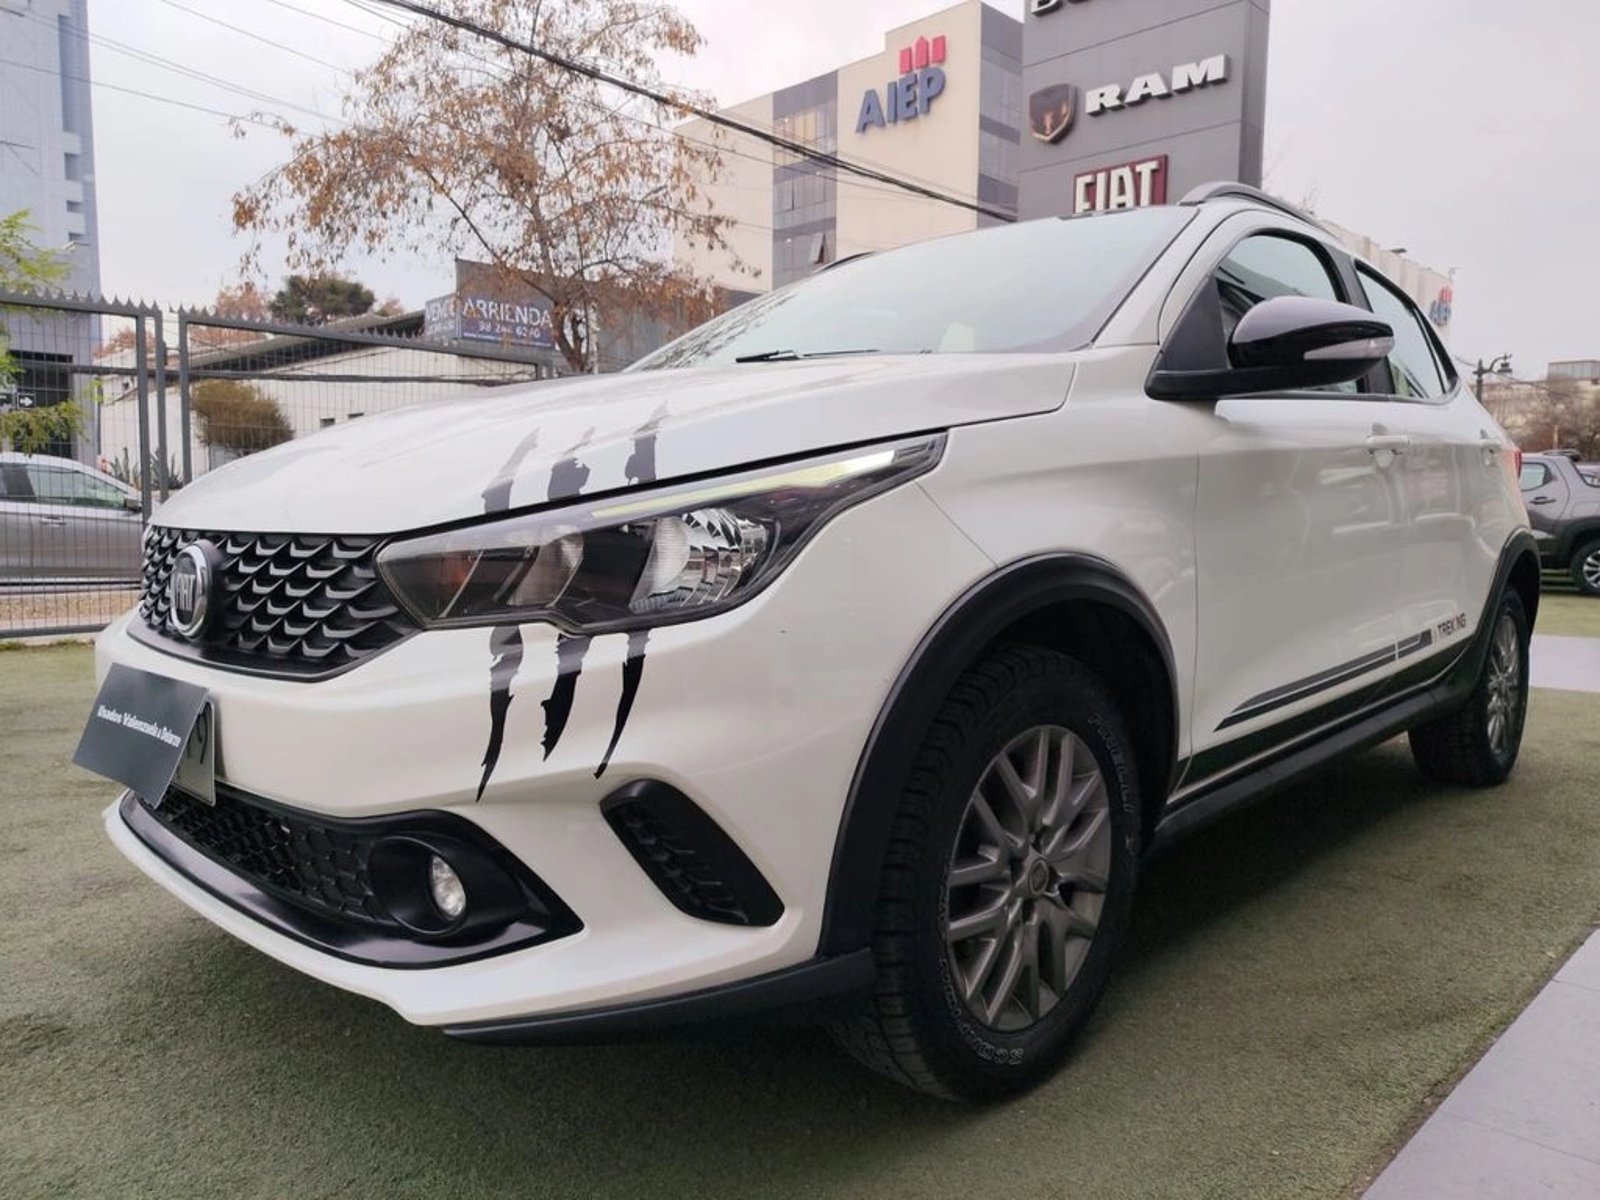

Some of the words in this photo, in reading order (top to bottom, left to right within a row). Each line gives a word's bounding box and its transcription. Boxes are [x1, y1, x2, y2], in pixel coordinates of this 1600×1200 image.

[856, 67, 946, 133] AIEP
[1085, 53, 1228, 117] RAM
[1075, 160, 1159, 214] FIAT
[462, 297, 553, 328] ARRIENDA
